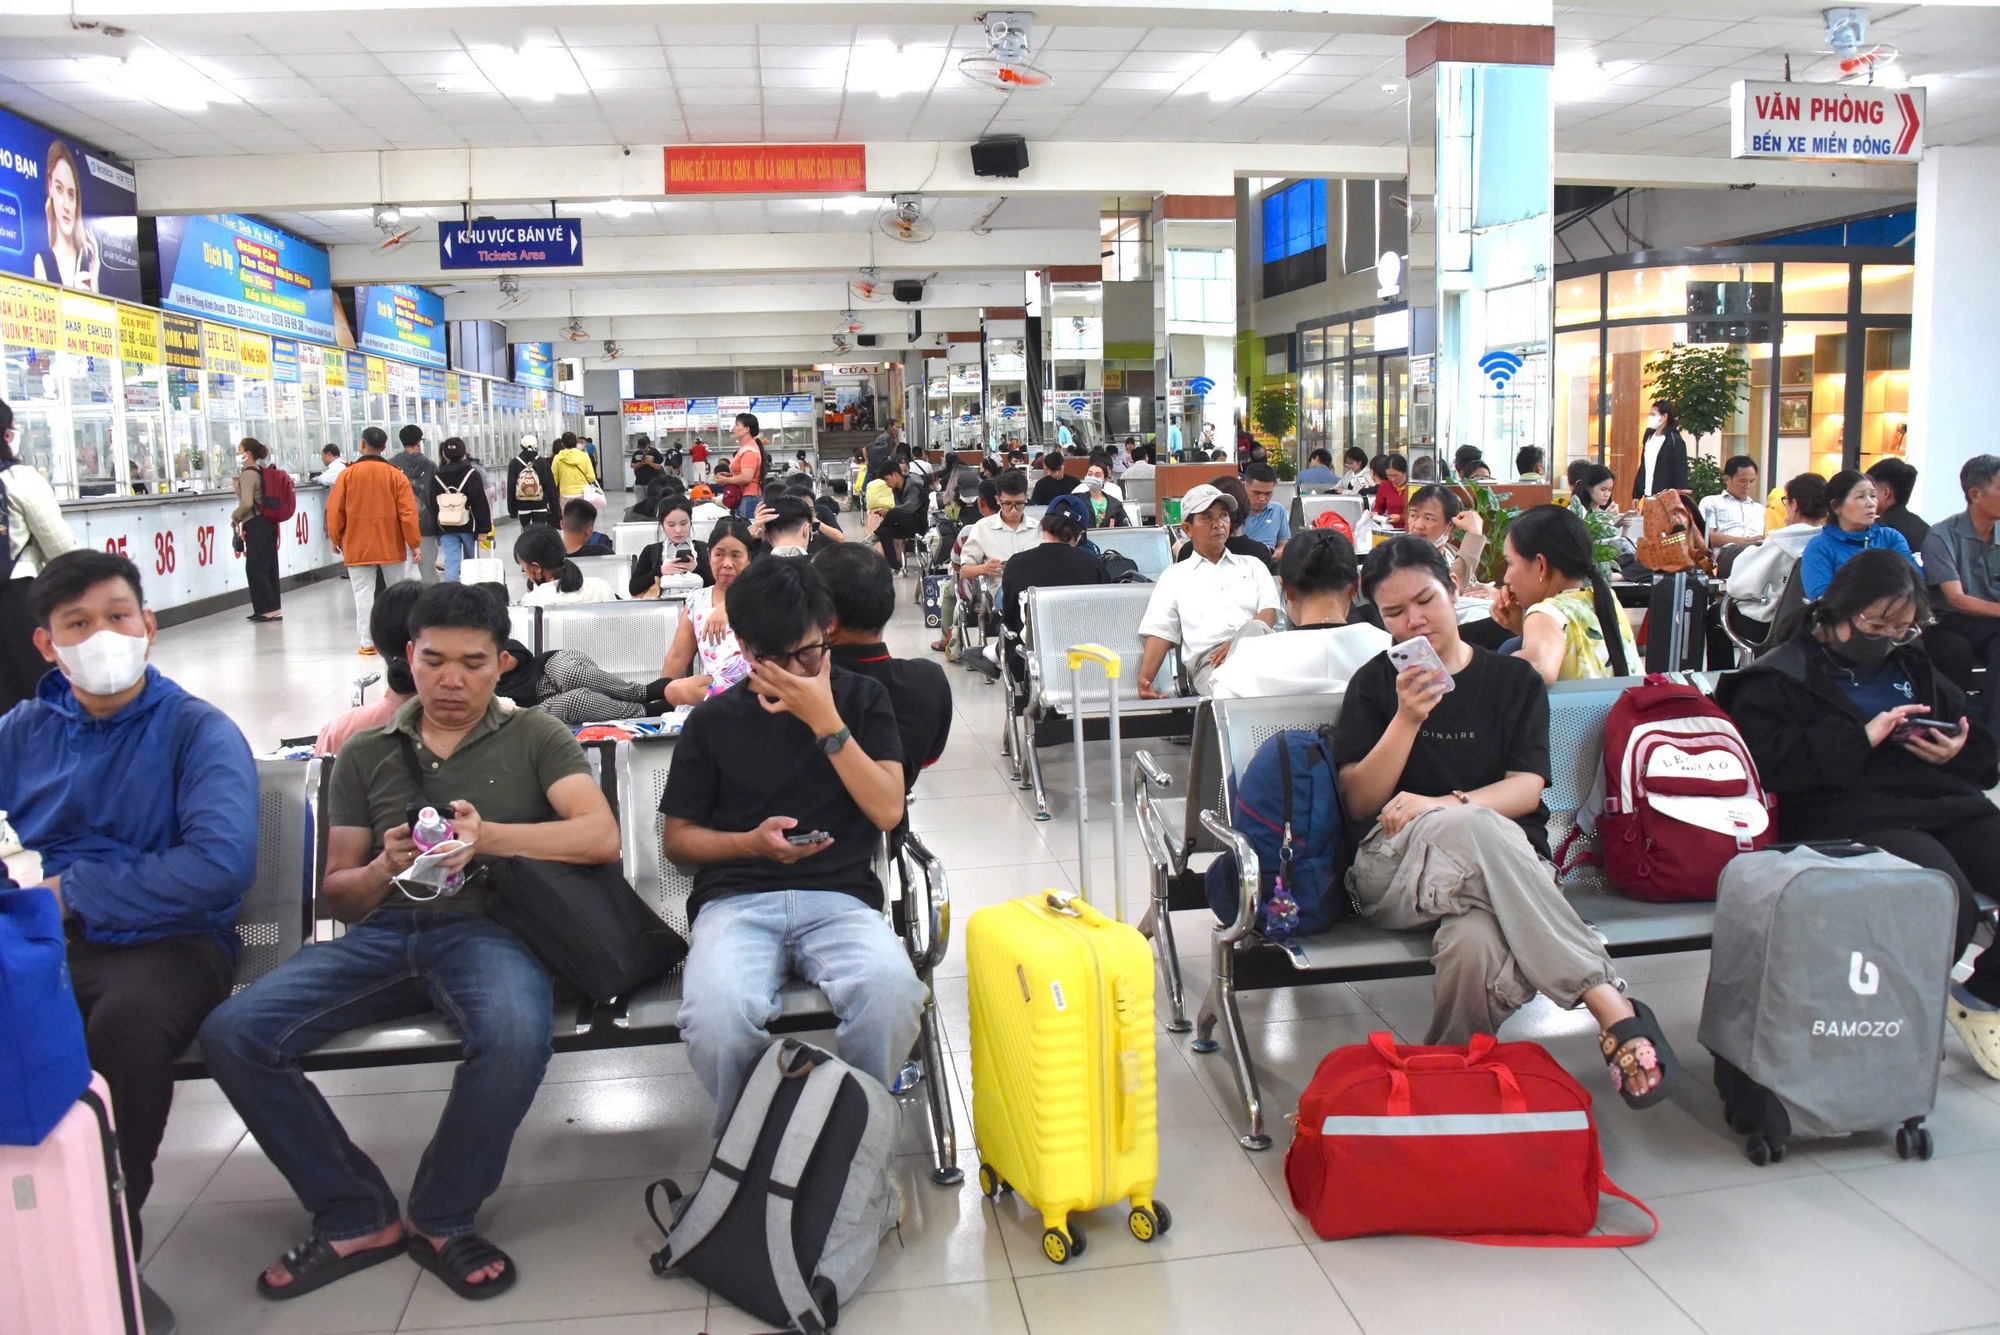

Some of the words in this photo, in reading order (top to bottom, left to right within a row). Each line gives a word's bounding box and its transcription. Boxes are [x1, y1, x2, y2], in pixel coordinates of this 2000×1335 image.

[1755, 92, 1800, 121] VĂN
[1810, 93, 1883, 124] PHÒNG
[1752, 129, 1782, 152] BẾN
[1787, 136, 1806, 153] XE
[1812, 131, 1847, 154] MIỀN
[1853, 135, 1891, 155] ĐÔNG
[15, 154, 38, 179] BẠN
[458, 230, 485, 244] KHU
[488, 227, 514, 246] VỰC
[518, 226, 544, 242] BÁN
[547, 224, 564, 242] VÉ
[203, 241, 222, 269] Dịch
[223, 247, 234, 275] Vụ
[478, 250, 518, 262] Tickets
[520, 250, 546, 260] Area
[121, 316, 135, 327] GIA
[223, 331, 236, 352] HÀ
[295, 512, 308, 545] 40
[154, 530, 176, 576] 36
[197, 526, 214, 567] 37
[1422, 730, 1475, 740] DINAIRE
[1812, 1020, 1900, 1037] BAMOZO
